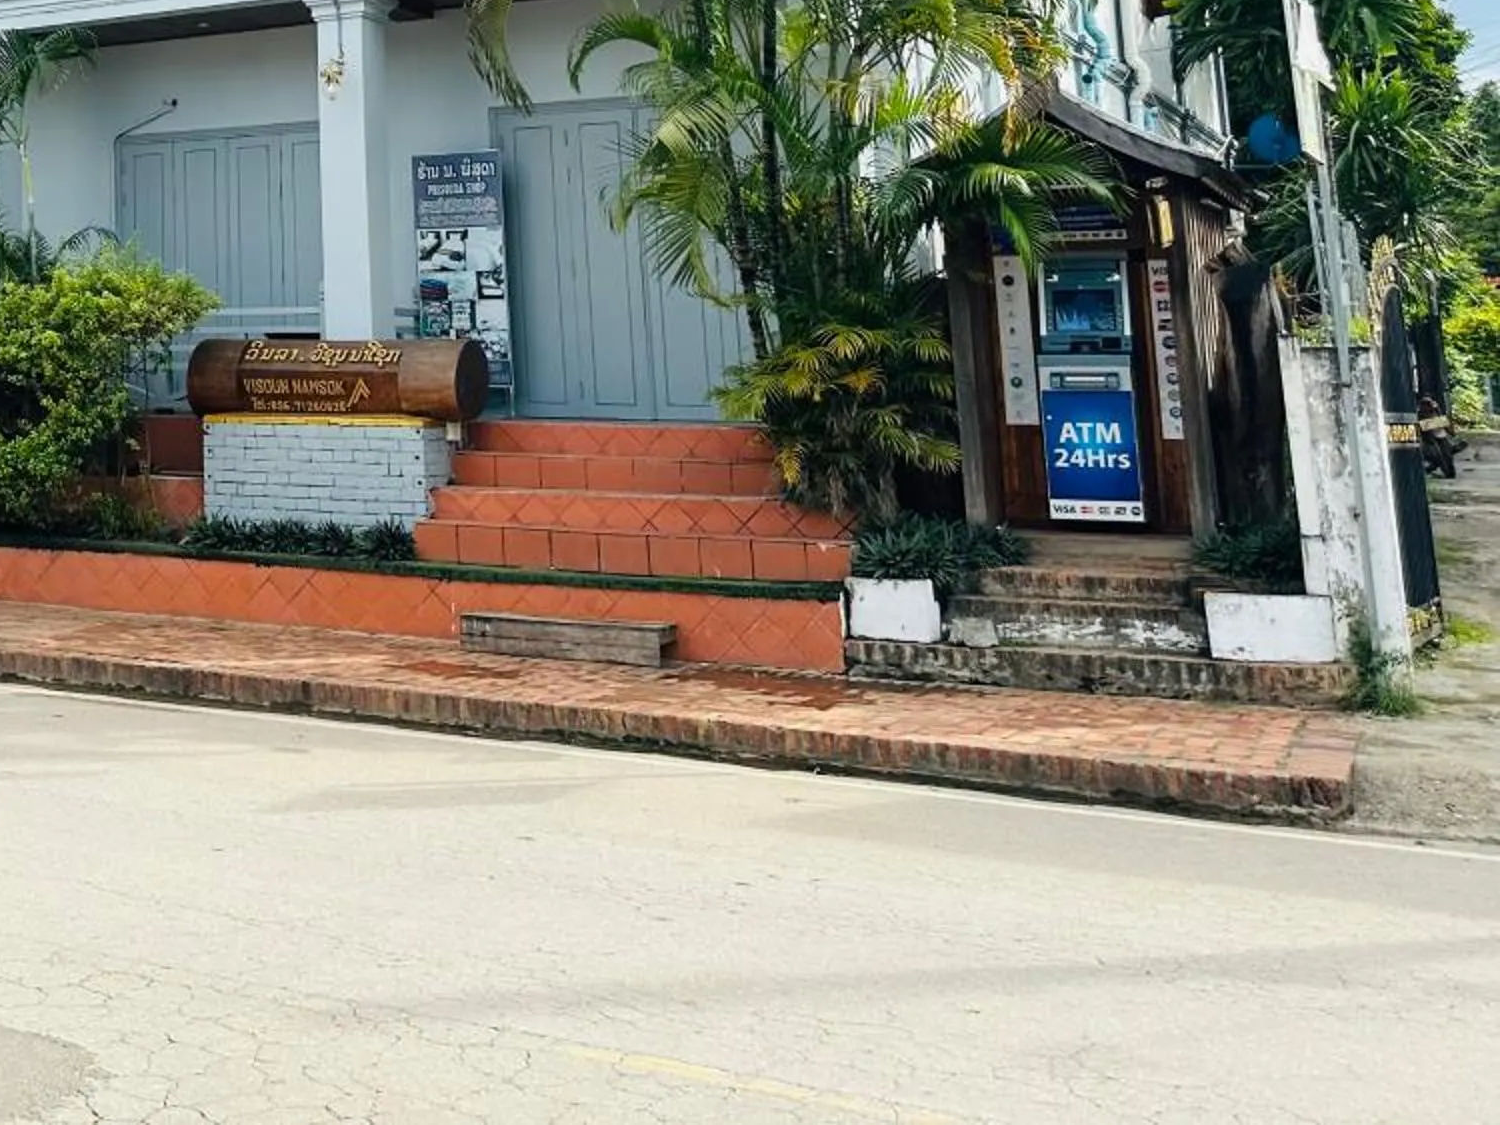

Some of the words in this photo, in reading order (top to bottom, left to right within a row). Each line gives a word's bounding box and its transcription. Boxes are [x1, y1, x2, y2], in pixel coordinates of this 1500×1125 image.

[243, 378, 290, 395] VISOUN
[291, 379, 346, 396] NAMSOK
[1059, 422, 1122, 444] ATM
[1054, 448, 1132, 469] 24Hrs
[1053, 504, 1077, 514] VISA
